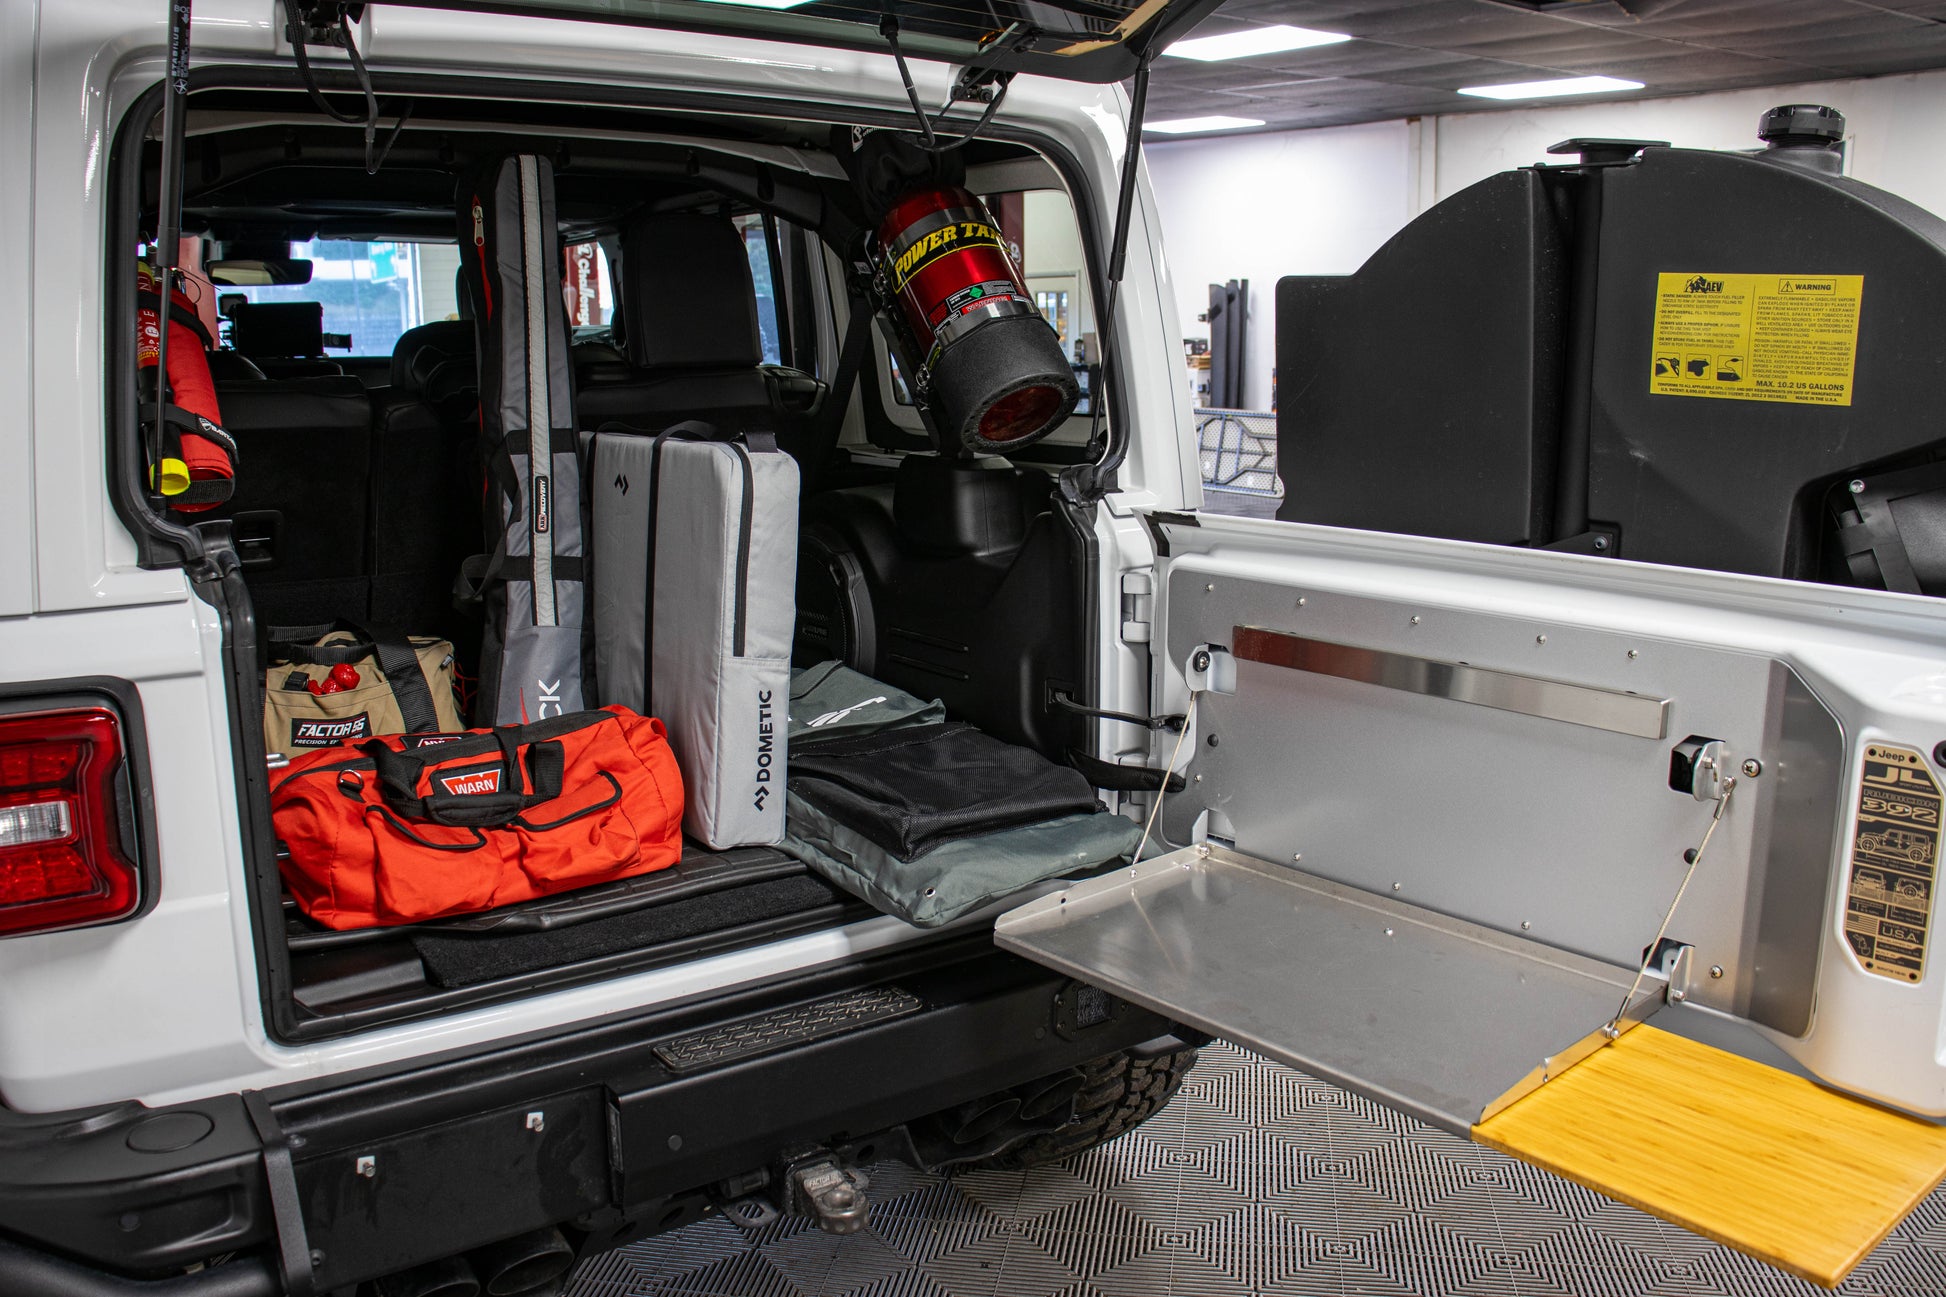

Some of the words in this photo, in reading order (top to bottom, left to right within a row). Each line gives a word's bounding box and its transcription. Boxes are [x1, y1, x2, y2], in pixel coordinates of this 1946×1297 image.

[894, 225, 957, 286] POWER
[1705, 281, 1723, 292] AEV
[1809, 383, 1845, 391] GALLONS
[538, 679, 563, 720] CK
[298, 722, 353, 737] FACTOR
[756, 689, 773, 782] DOMETIC
[1878, 750, 1905, 762] Jeep
[1865, 766, 1931, 786] JL
[454, 779, 495, 795] WARN
[1862, 797, 1937, 824] 392
[1882, 925, 1919, 944] U.S.A.
